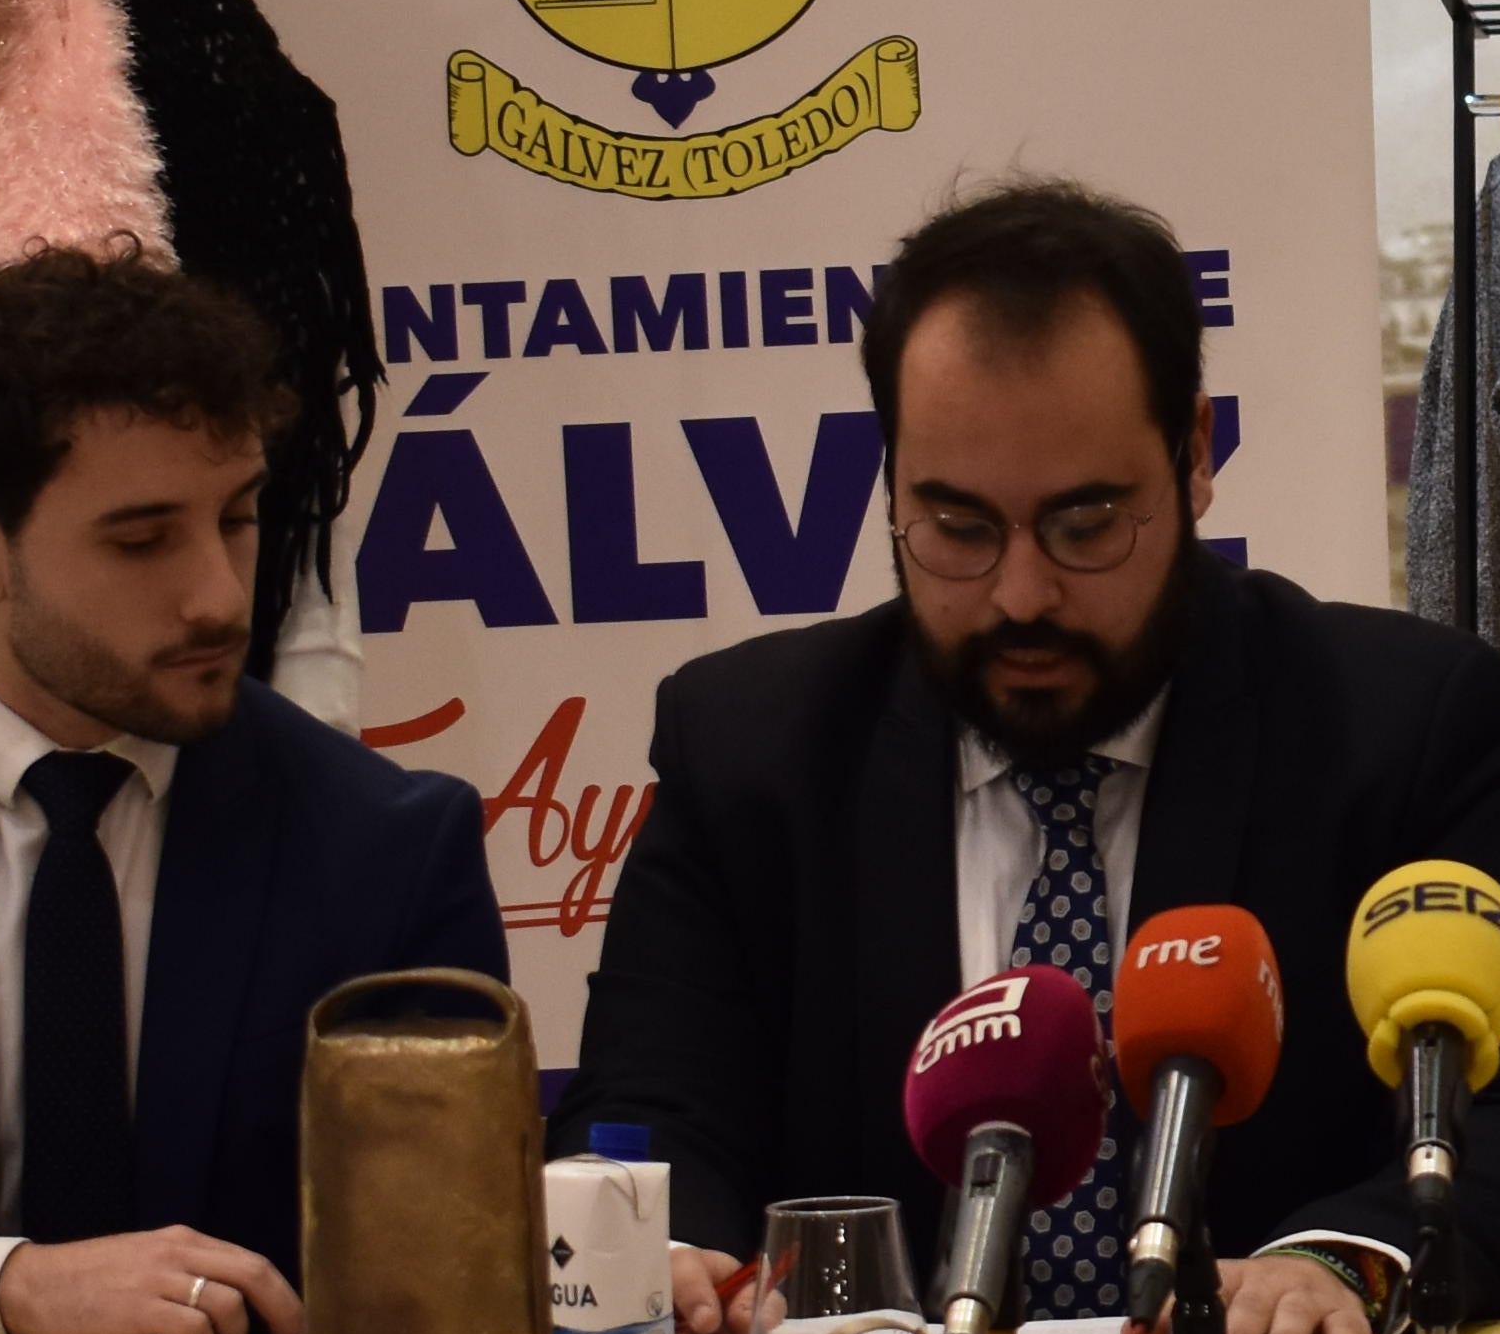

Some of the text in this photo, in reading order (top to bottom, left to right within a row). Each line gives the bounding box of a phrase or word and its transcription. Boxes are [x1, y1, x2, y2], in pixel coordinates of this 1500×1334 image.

[682, 70, 874, 192] (TOLEDO)
[1136, 932, 1223, 970] rne
[913, 1012, 1024, 1075] cmm
[550, 1283, 598, 1308] GUA
